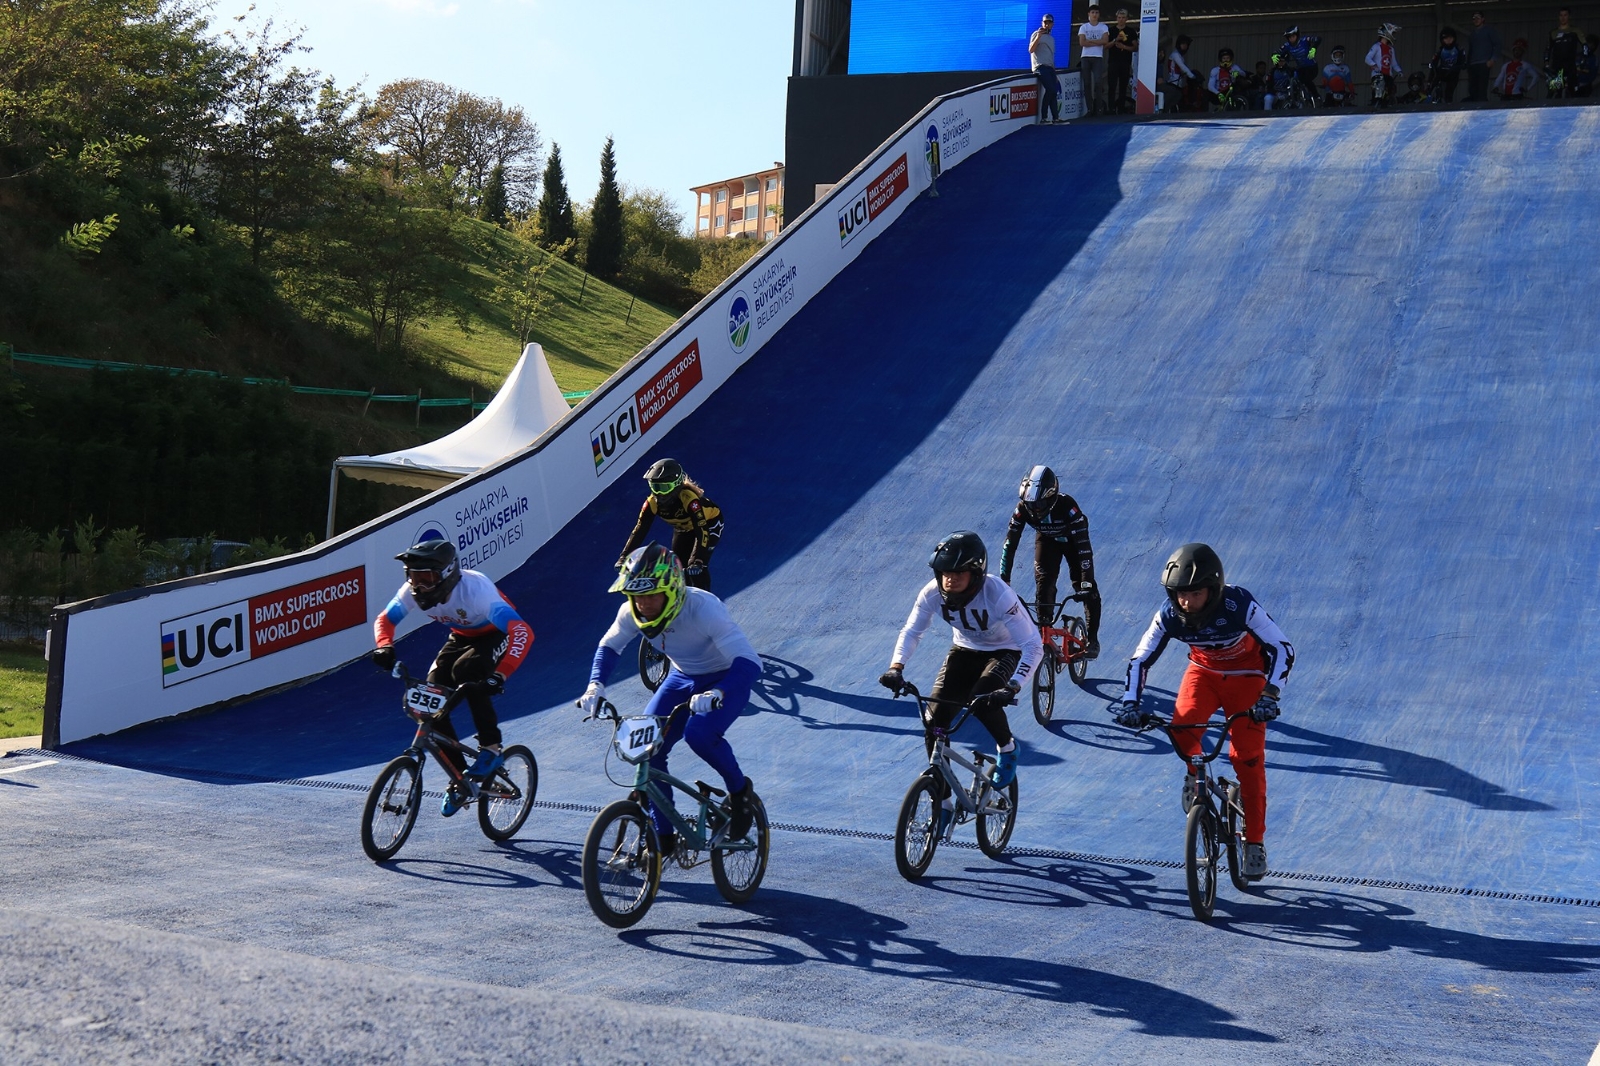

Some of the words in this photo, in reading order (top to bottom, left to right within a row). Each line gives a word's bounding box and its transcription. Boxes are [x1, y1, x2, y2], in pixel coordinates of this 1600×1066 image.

[942, 108, 964, 128] SAKARYA
[994, 93, 1010, 115] UCI
[869, 186, 880, 201] BMX
[880, 161, 906, 192] SUPERCROSS
[869, 192, 886, 214] WORLD
[886, 184, 895, 199] CUP
[844, 196, 868, 235] UCI
[753, 258, 785, 294] SAKARYA
[755, 265, 798, 312] BÜYÜKŞEHİR
[757, 283, 795, 330] BELEDİYESİ
[639, 386, 657, 409] BMX
[656, 350, 697, 394] SUPERCROSS
[641, 395, 666, 424] WORLD
[666, 382, 680, 401] CUP
[600, 405, 637, 458] UCI
[455, 485, 509, 528] SAKARYA
[458, 496, 529, 552] BÜYÜKŞEHİR
[460, 519, 524, 570] BELEDİYESİ
[255, 605, 284, 624] BMX
[287, 578, 360, 614] SUPERCROSS
[941, 604, 990, 632] FLY
[177, 613, 244, 668] UCI
[255, 617, 300, 646] WORLD
[303, 610, 327, 631] CUP
[1017, 661, 1032, 677] FLY
[410, 691, 442, 710] 938
[629, 725, 655, 750] 120
